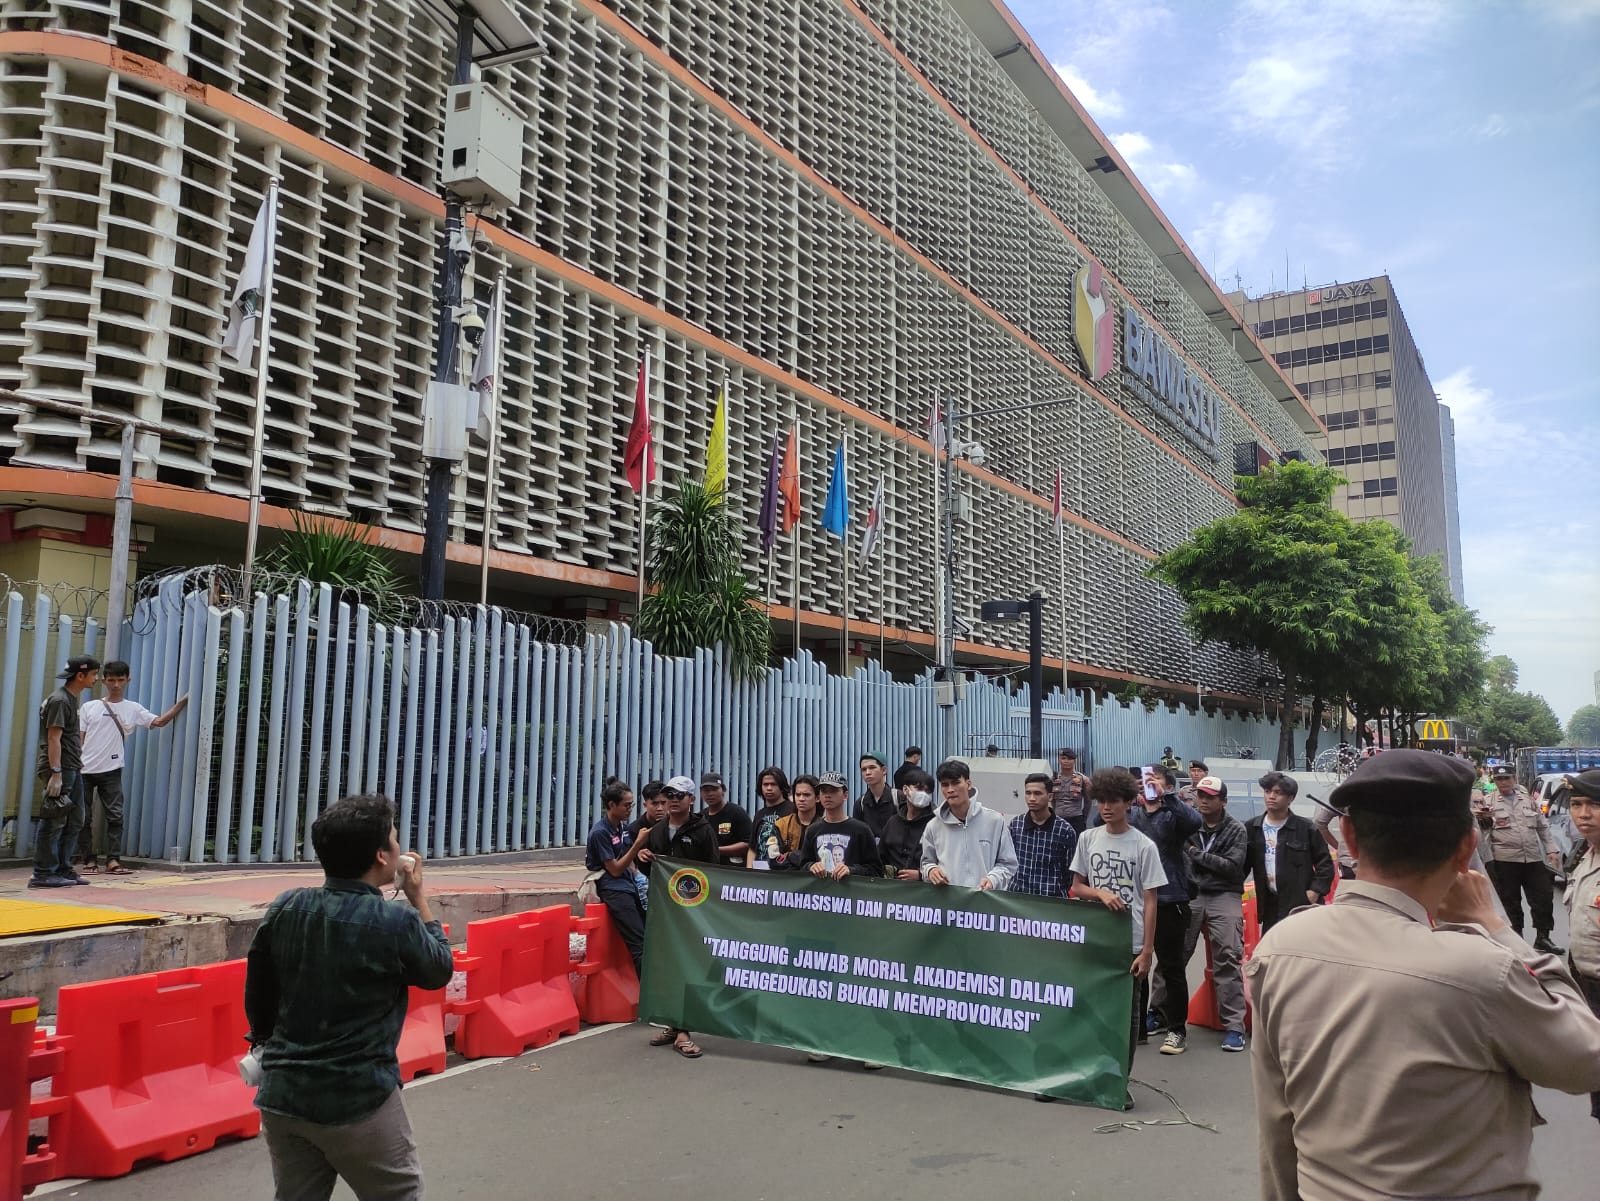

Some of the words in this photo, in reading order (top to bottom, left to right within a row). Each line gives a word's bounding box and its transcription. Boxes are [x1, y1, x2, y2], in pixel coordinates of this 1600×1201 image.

[1323, 283, 1376, 302] JAYA
[1124, 306, 1220, 445] BAWASLU
[720, 885, 769, 906] ALIANSI
[772, 890, 852, 915] MAHASISWA
[856, 899, 883, 919] DAN
[886, 903, 942, 926] PEMUDA
[946, 909, 995, 932] PEDULI
[999, 915, 1086, 944] DEMOKRASI
[703, 936, 789, 966] "TANGGUNG
[793, 949, 849, 974] JAWAB
[852, 956, 908, 983] MORAL
[913, 965, 1005, 998] AKADEMISI
[1010, 978, 1074, 1008] DALAM
[724, 966, 832, 1001] MENGEDUKASI
[837, 982, 889, 1009] BUKAN
[893, 991, 1041, 1033] MEMPROVOKASI"
